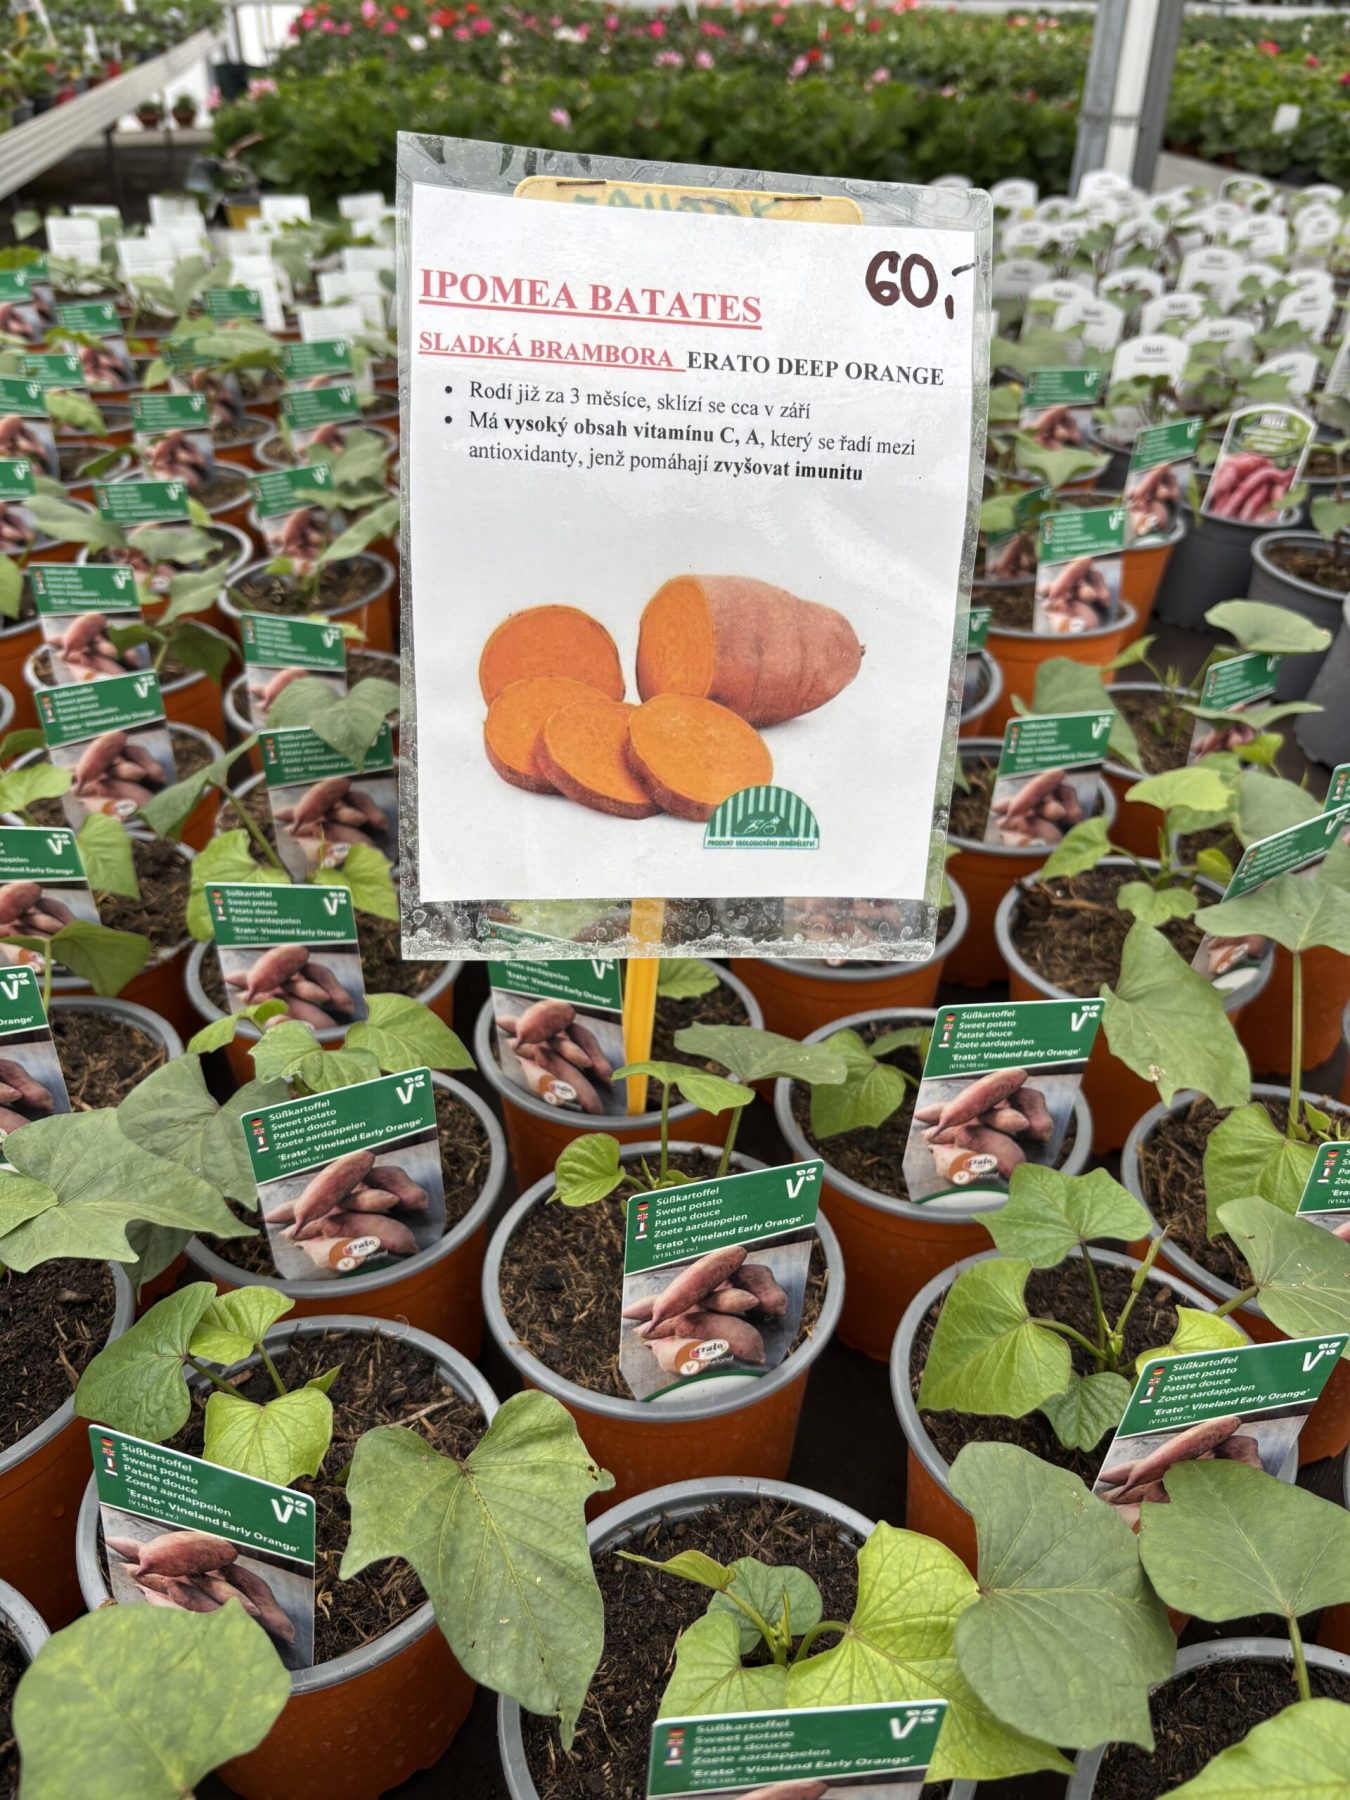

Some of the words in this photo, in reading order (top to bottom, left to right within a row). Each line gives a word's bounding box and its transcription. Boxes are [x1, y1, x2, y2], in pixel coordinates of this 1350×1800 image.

[419, 268, 578, 309] IPOMEA
[589, 283, 762, 323] BATATES
[419, 331, 522, 357] SLADKÁ
[529, 339, 673, 367] BRAMBORA
[687, 351, 770, 374] ERATO
[777, 357, 838, 378] DEEP
[845, 362, 944, 386] ORANGE
[470, 381, 512, 400] Rodí
[516, 385, 540, 405] již
[546, 390, 564, 403] za
[570, 388, 579, 404] 3
[587, 391, 651, 411] měsíce,
[657, 393, 702, 412] sklízí
[709, 401, 725, 413] se
[731, 404, 758, 415] cca
[765, 405, 774, 416] v
[780, 402, 810, 419] září
[469, 411, 498, 429] Má
[504, 417, 568, 437] vysoký
[574, 419, 627, 437] obsah
[633, 422, 713, 442] vitamínu
[720, 427, 740, 446] C,
[745, 429, 765, 448] A,
[771, 430, 812, 451] který
[818, 438, 835, 450] se
[839, 436, 872, 452] řadí
[877, 439, 915, 455] mezi
[469, 443, 583, 467] antioxidanty,
[587, 448, 625, 469] jenž
[630, 453, 709, 476] pomáhají
[713, 458, 789, 477] zvyšovat
[795, 461, 862, 480] imunitu
[271, 1118, 302, 1131] Sweet
[304, 1109, 337, 1123] potato
[273, 1128, 305, 1140] Patate
[307, 1119, 337, 1132] douce
[275, 1138, 304, 1150] Zoete
[305, 1121, 366, 1142] aardappelen
[314, 1135, 358, 1152] Vineland
[360, 1128, 384, 1140] Early
[656, 1206, 686, 1217] Sweet
[689, 1198, 723, 1211] potato
[657, 1187, 719, 1206] Süßkartoffel
[654, 1226, 683, 1238] Zoete
[685, 1213, 748, 1232] aardappelen
[655, 1216, 688, 1227] Patate
[690, 1209, 720, 1220] douce
[691, 1228, 736, 1242] Vineland
[738, 1223, 762, 1235] Early
[1162, 1382, 1197, 1393] Patate
[1199, 1377, 1231, 1388] douce
[1167, 1371, 1200, 1382] Sweet
[1202, 1366, 1237, 1379] potato
[1157, 1392, 1189, 1403] Zoete
[1190, 1383, 1256, 1400] aardappelen
[1191, 1396, 1238, 1411] Vineland
[1239, 1393, 1267, 1405] Early
[121, 1442, 192, 1472] Süßkartoffel
[122, 1453, 158, 1471] Sweet
[160, 1466, 199, 1485] potato
[124, 1464, 161, 1482] Patate
[163, 1477, 198, 1495] douce
[125, 1475, 158, 1493] Zoete
[160, 1488, 232, 1517] aardappelen
[169, 1502, 220, 1526] Vineland
[222, 1521, 252, 1537] Early
